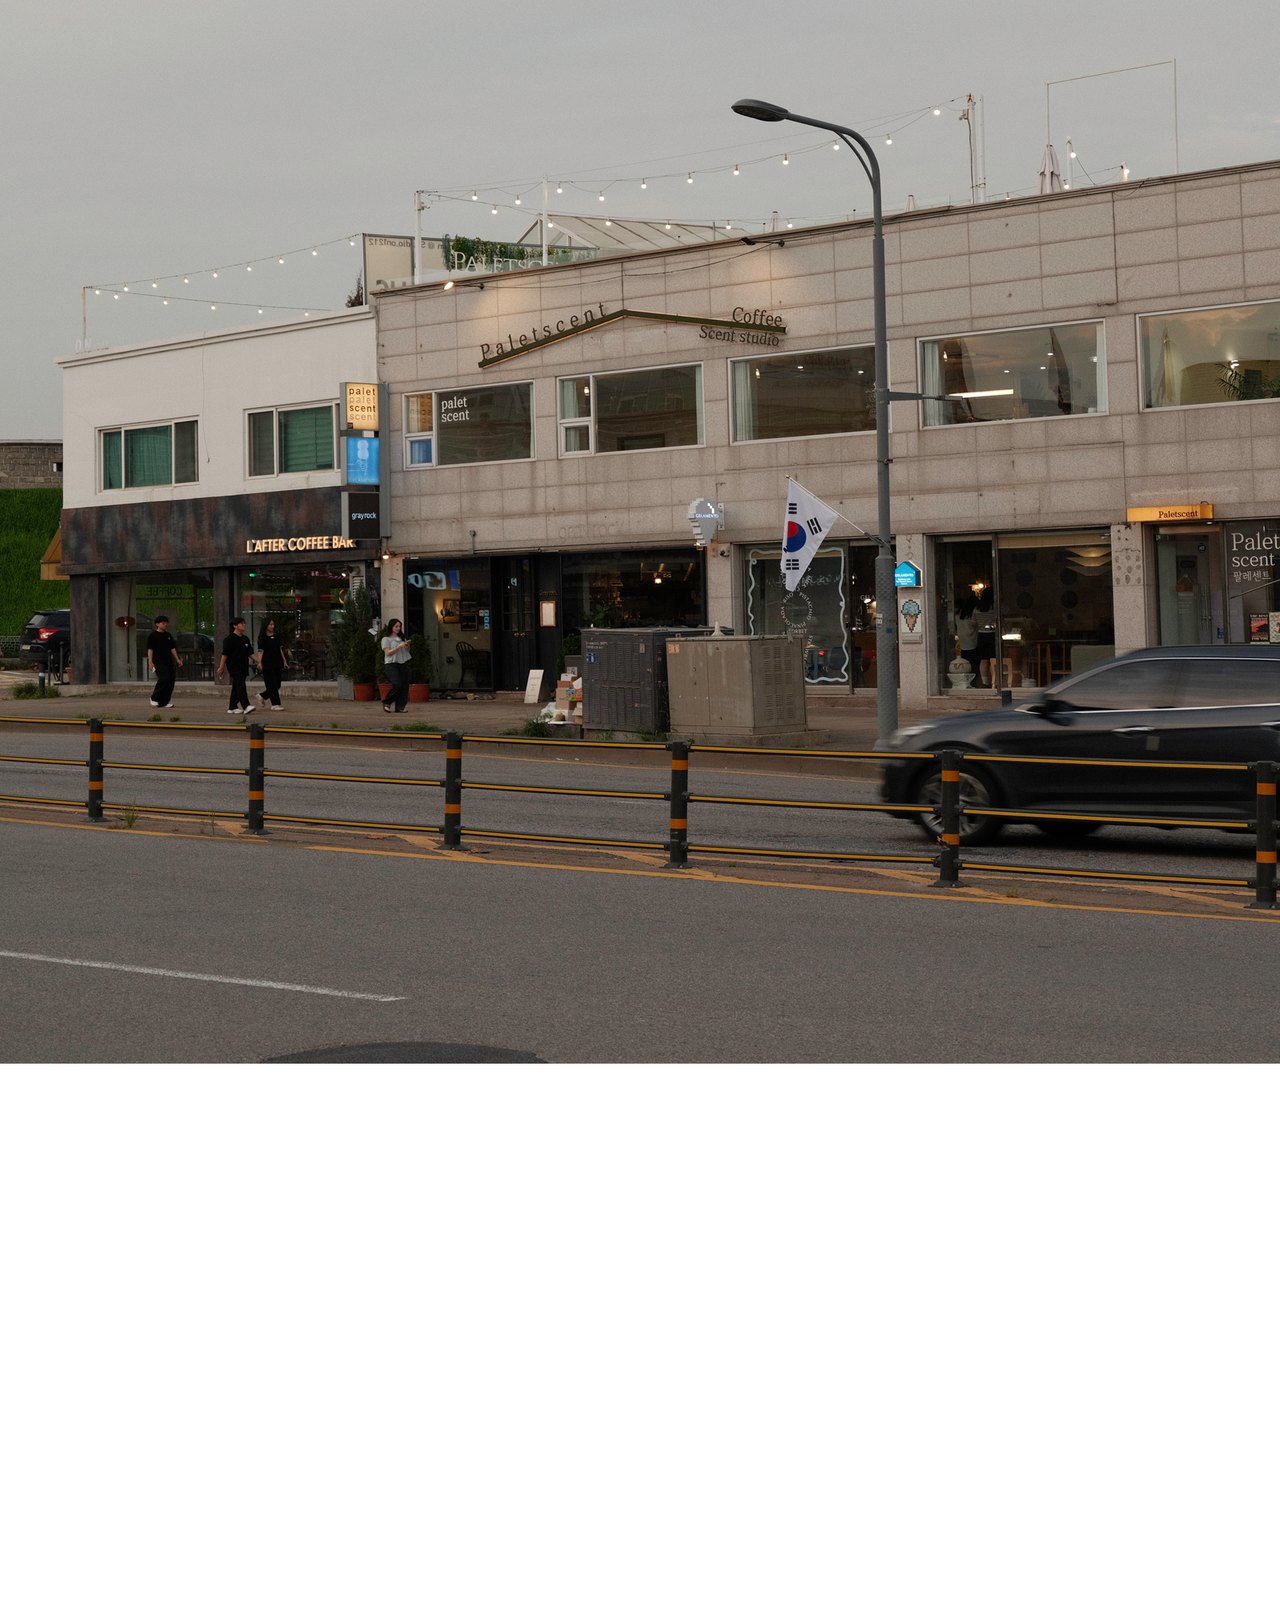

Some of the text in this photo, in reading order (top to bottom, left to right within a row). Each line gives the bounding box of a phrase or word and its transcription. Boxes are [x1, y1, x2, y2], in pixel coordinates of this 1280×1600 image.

[732, 306, 783, 327] Coffee
[479, 302, 607, 361] Paletscent
[698, 325, 781, 347] Scent studio
[349, 387, 376, 396] palet
[349, 396, 376, 404] palet
[441, 396, 468, 413] palet
[349, 404, 376, 413] scent
[349, 413, 376, 422] scent
[441, 409, 470, 423] scent
[351, 511, 377, 520] grayrock
[1158, 509, 1198, 519] Paletscent
[288, 535, 329, 552] COFFEE
[332, 535, 355, 550] BAR
[1231, 531, 1280, 551] Palet
[1231, 552, 1276, 568] scent
[1233, 570, 1271, 583] 팔레센트
